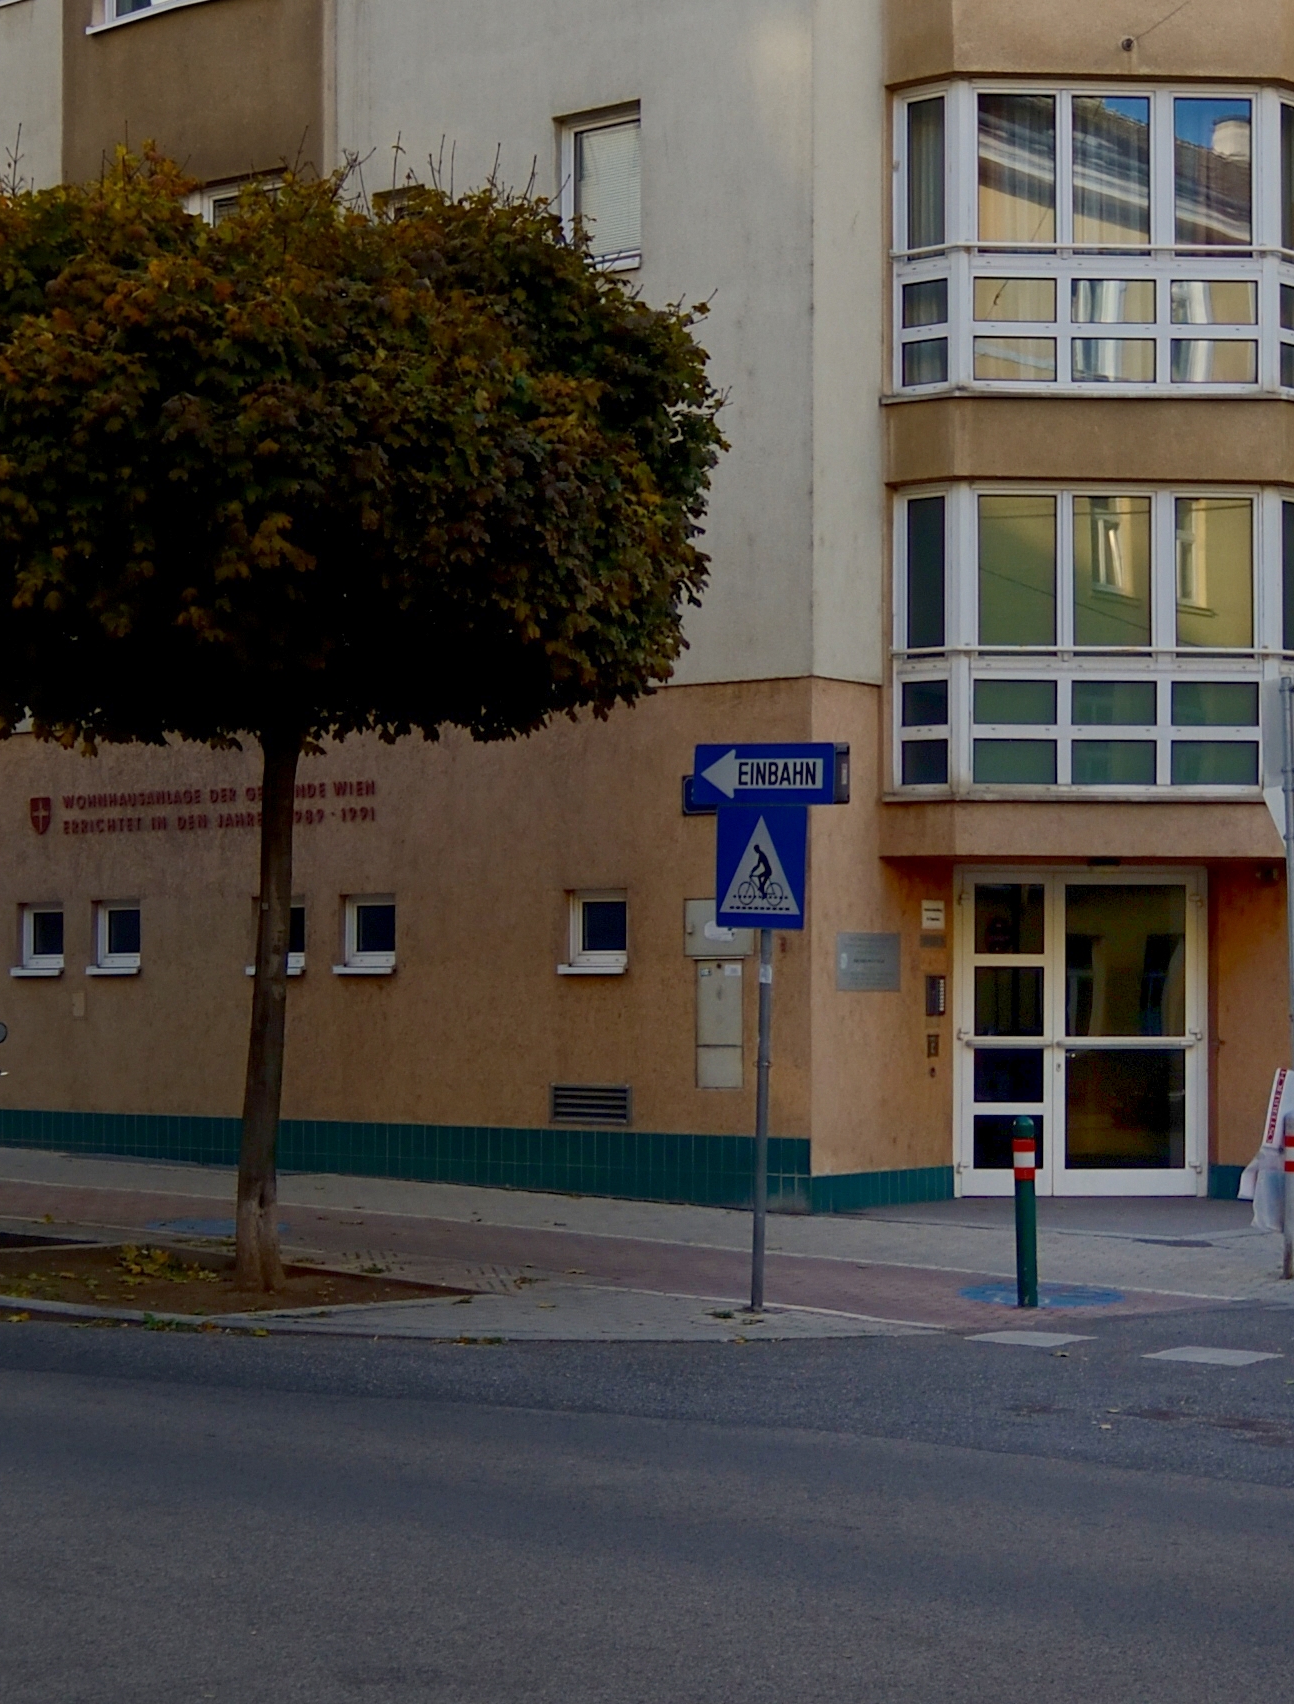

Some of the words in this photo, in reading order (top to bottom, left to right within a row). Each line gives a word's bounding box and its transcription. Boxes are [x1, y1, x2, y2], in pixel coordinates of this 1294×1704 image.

[738, 761, 817, 786] EINBAHN
[62, 789, 201, 810] WOHNHAUSANLAGE
[210, 787, 236, 804] DER
[333, 780, 375, 797] WIEN
[63, 817, 141, 835] ERRICHTET
[151, 816, 167, 831] IN
[177, 814, 207, 831] DEN
[341, 806, 375, 822] 1991
